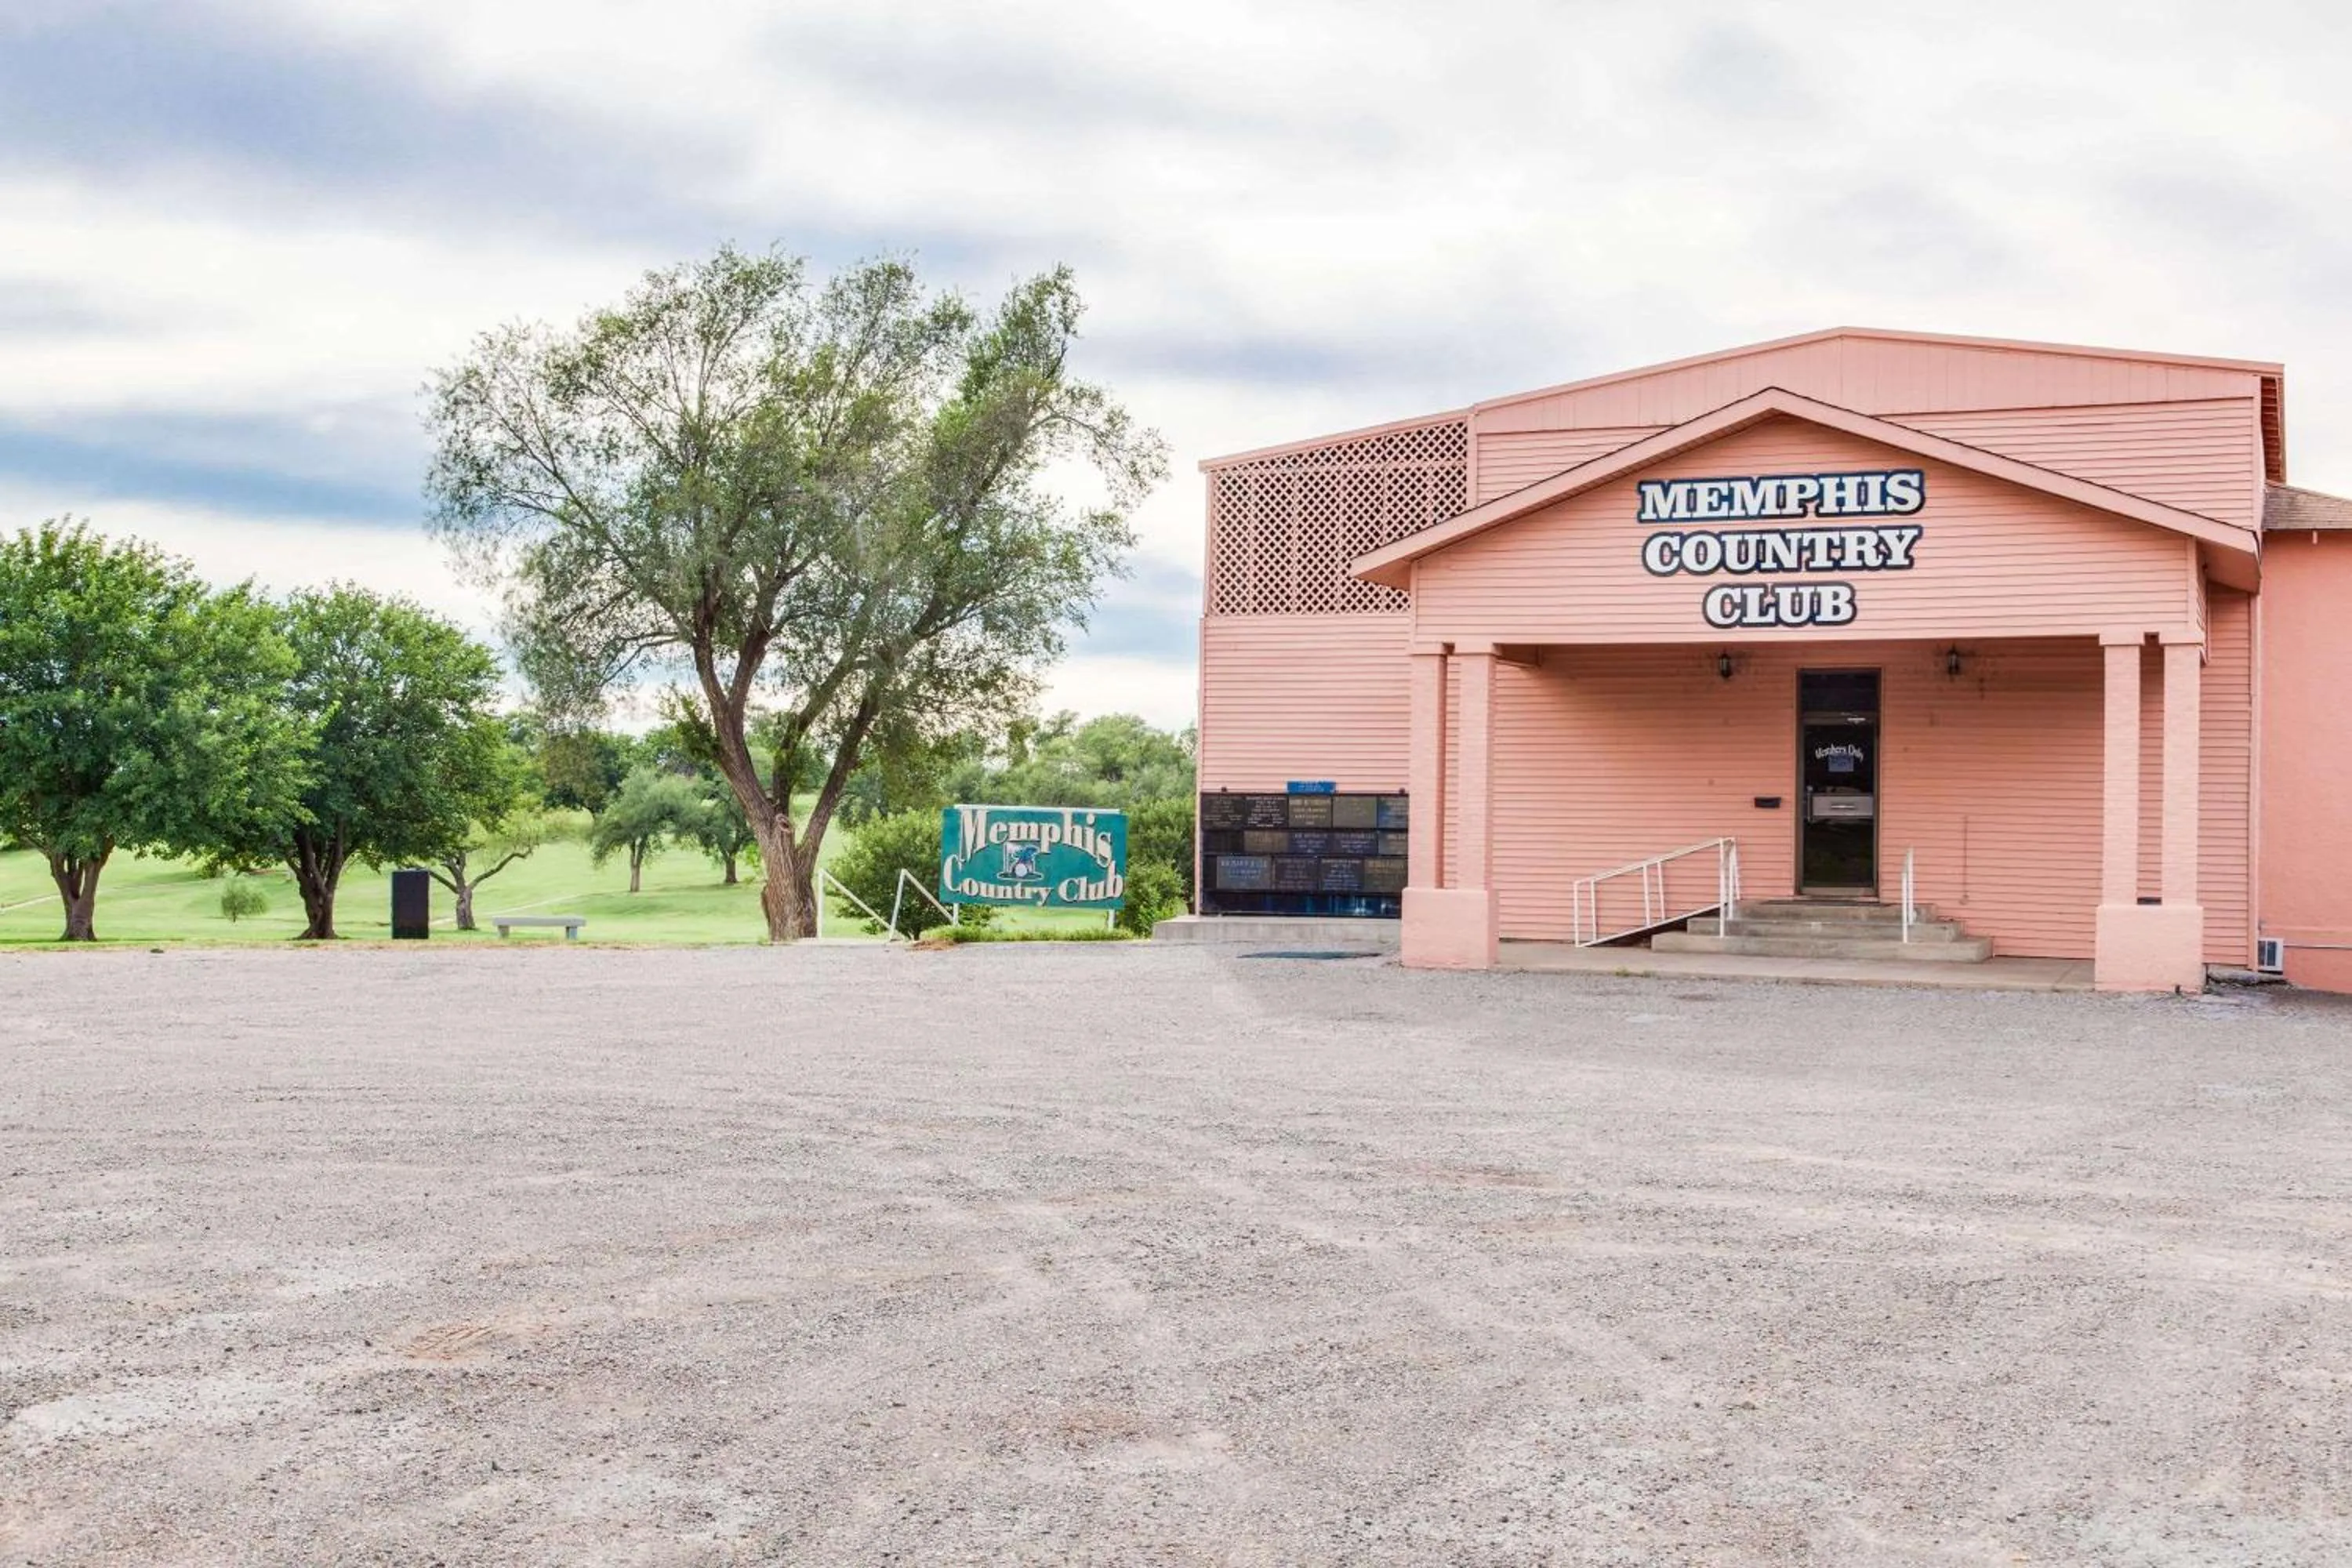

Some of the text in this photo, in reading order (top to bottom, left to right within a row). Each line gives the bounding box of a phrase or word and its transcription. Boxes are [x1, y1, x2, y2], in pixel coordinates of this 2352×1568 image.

[1639, 470, 1924, 522] MEMPHIS
[1642, 525, 1922, 575] COUNTRY
[1703, 582, 1857, 626] CLUB
[959, 808, 1112, 869] Memphis
[943, 854, 1123, 906] Country Club
